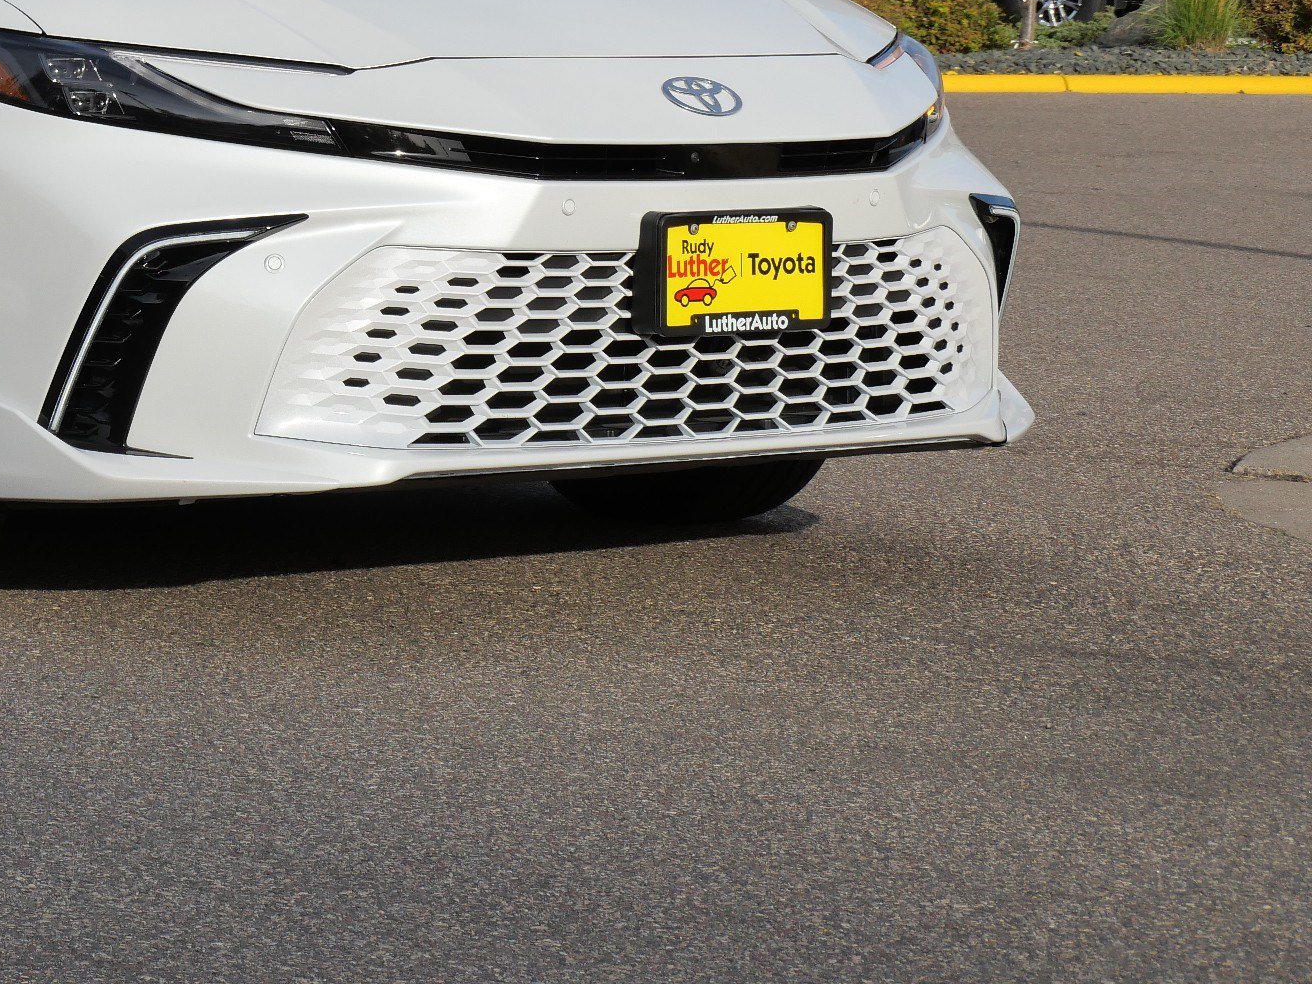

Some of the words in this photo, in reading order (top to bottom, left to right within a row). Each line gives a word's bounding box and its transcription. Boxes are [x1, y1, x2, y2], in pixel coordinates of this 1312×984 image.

[712, 214, 779, 224] LutherAuto.com
[681, 239, 714, 257] Rudy
[667, 254, 729, 278] Luther
[747, 252, 816, 280] Toyota
[704, 313, 789, 333] LutherAuto
